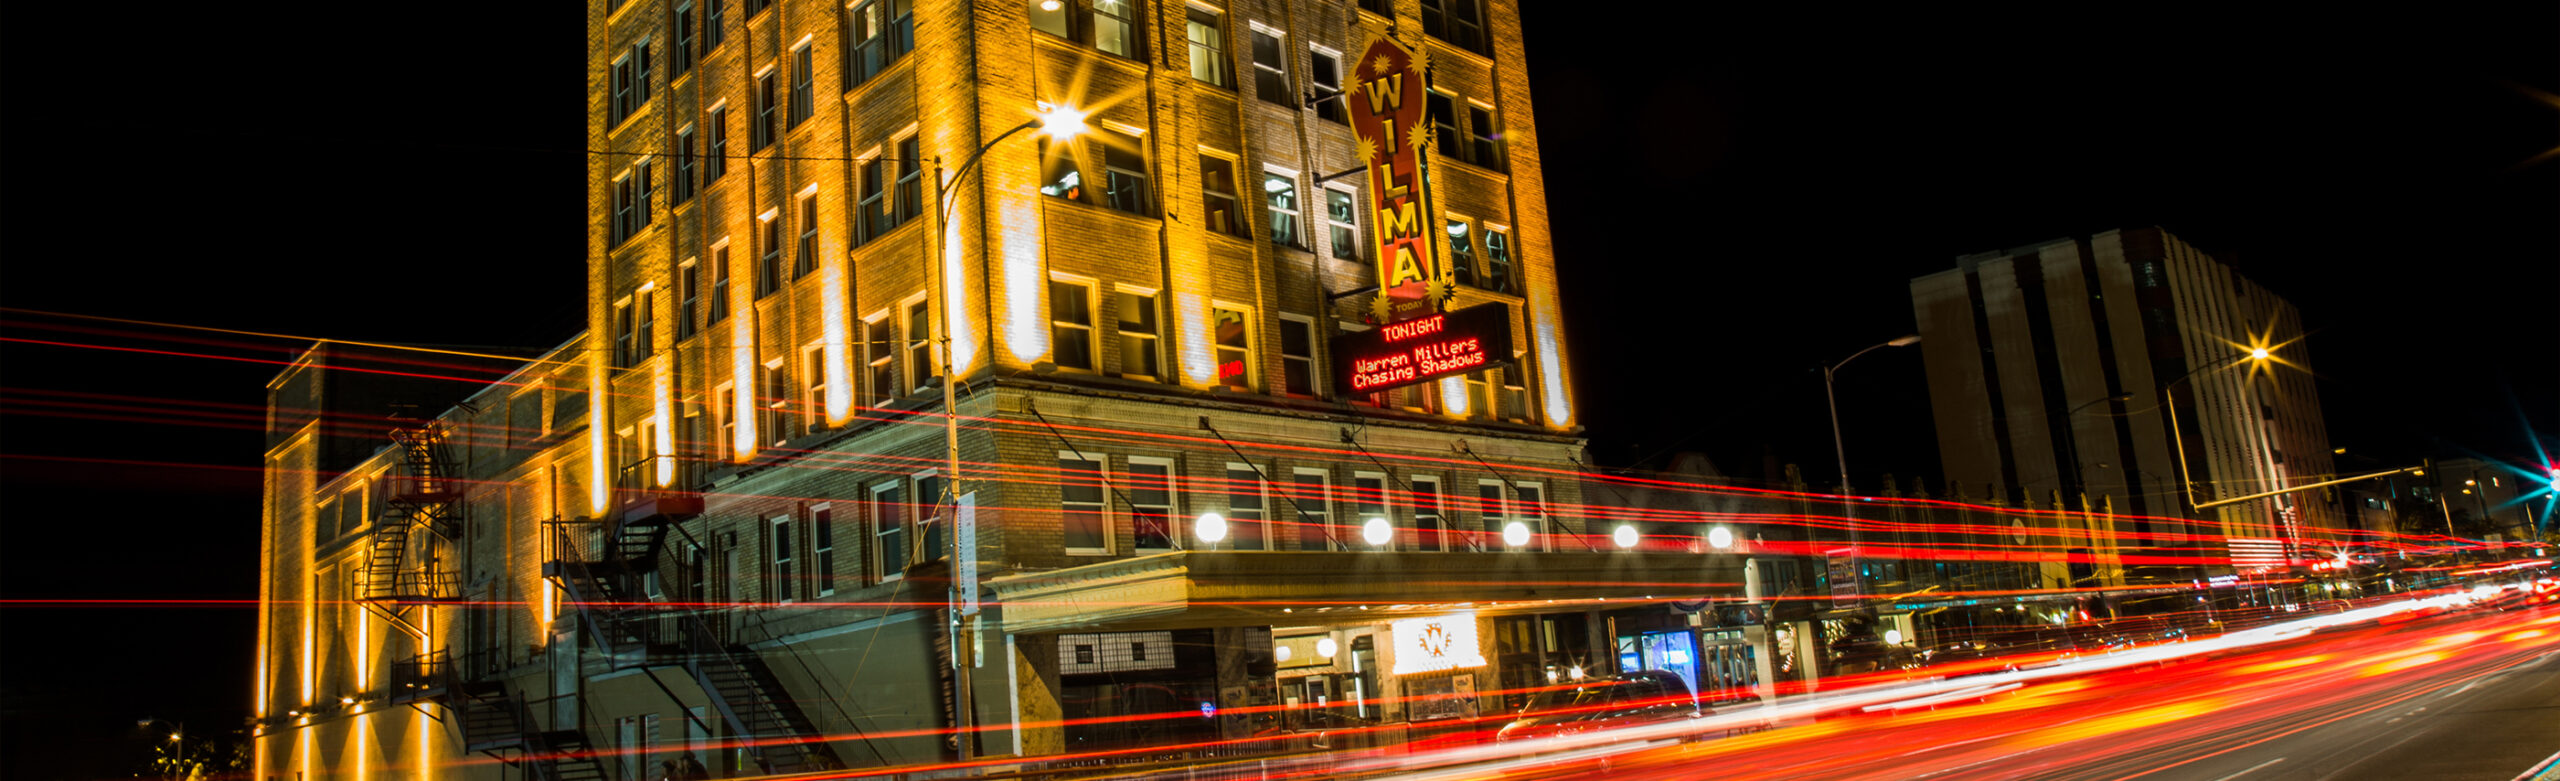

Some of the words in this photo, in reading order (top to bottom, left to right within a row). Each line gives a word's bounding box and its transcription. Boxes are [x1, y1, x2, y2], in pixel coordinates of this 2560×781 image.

[1365, 72, 1425, 288] WILMA
[1396, 299, 1423, 312] TODAY
[1383, 316, 1443, 341] TONIGHT
[1354, 367, 1414, 388] Chasing
[1421, 352, 1484, 374] Shadows
[1356, 354, 1408, 373] Warren
[1415, 339, 1478, 362] Millers
